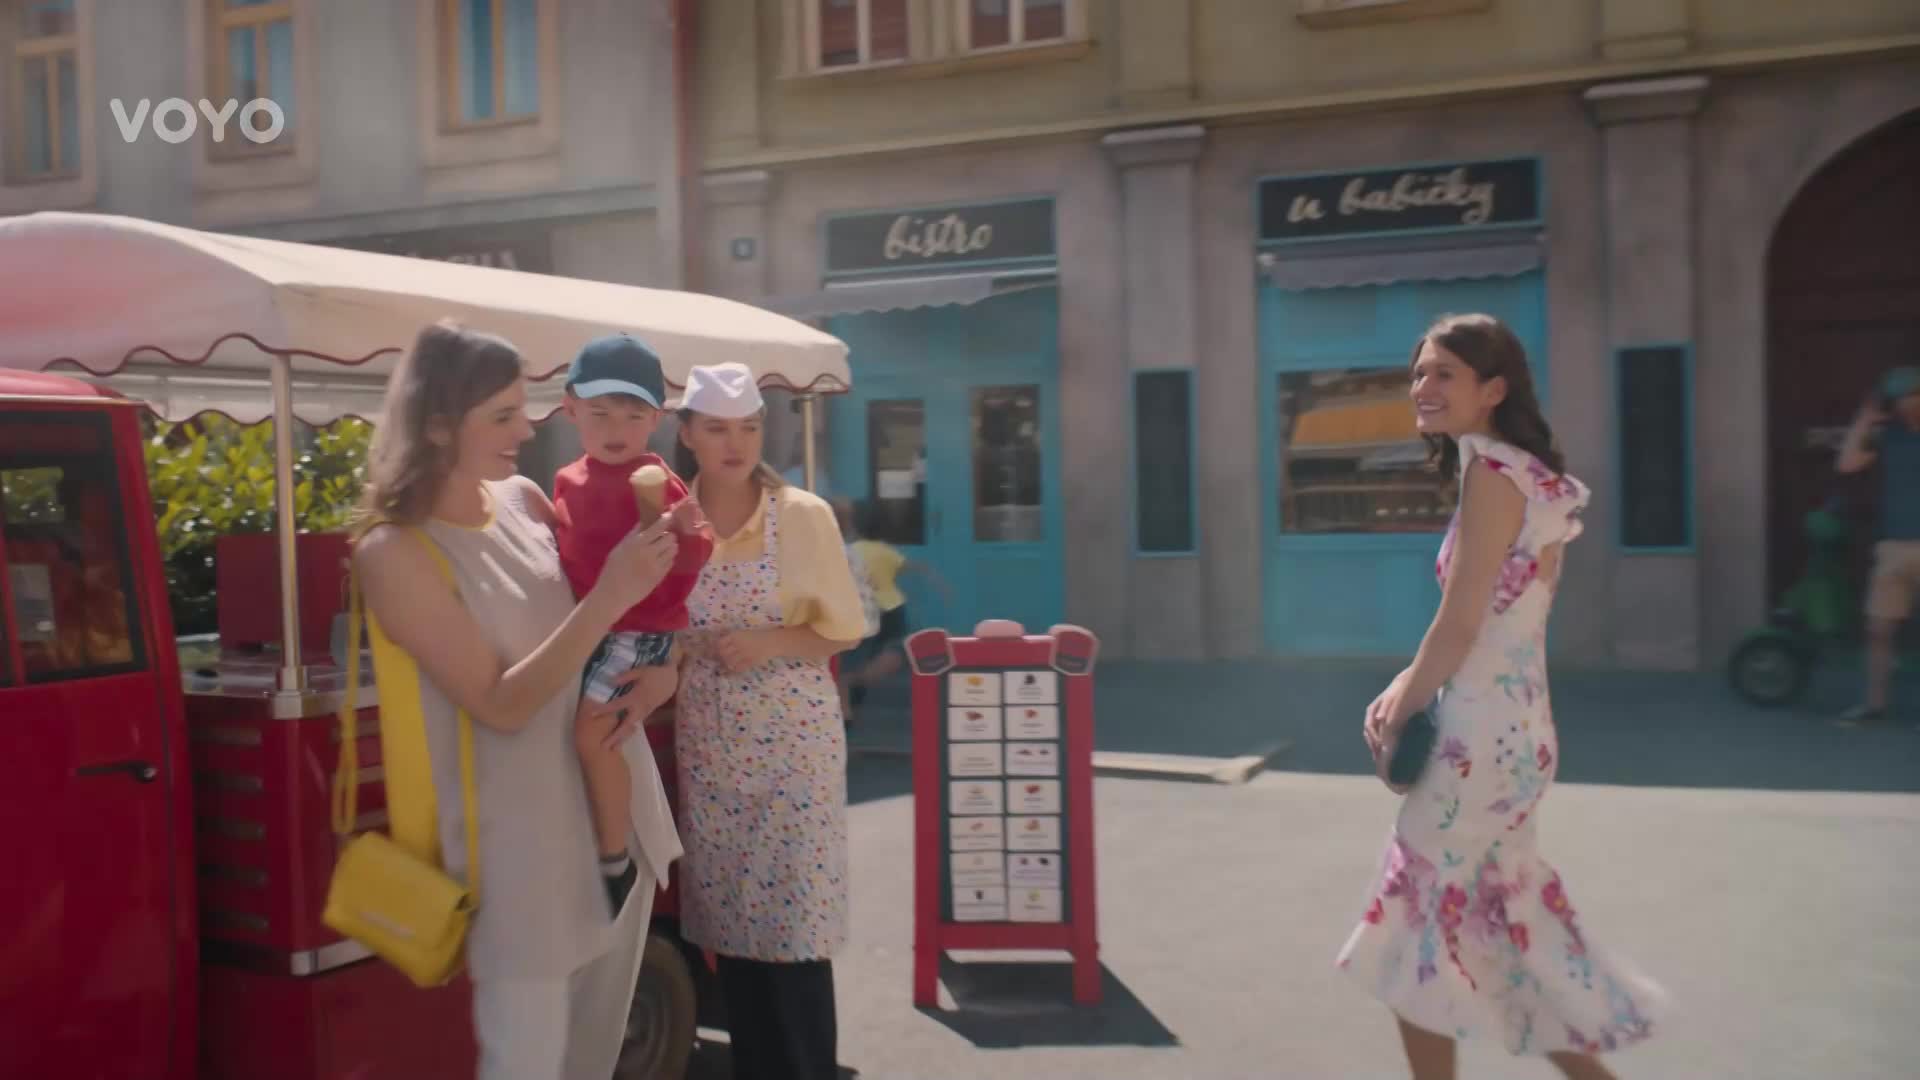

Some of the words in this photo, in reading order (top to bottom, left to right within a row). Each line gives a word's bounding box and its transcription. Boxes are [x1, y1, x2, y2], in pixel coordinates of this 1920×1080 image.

[1287, 195, 1326, 223] u
[1337, 167, 1495, 225] babičky
[884, 213, 993, 260] bistro
